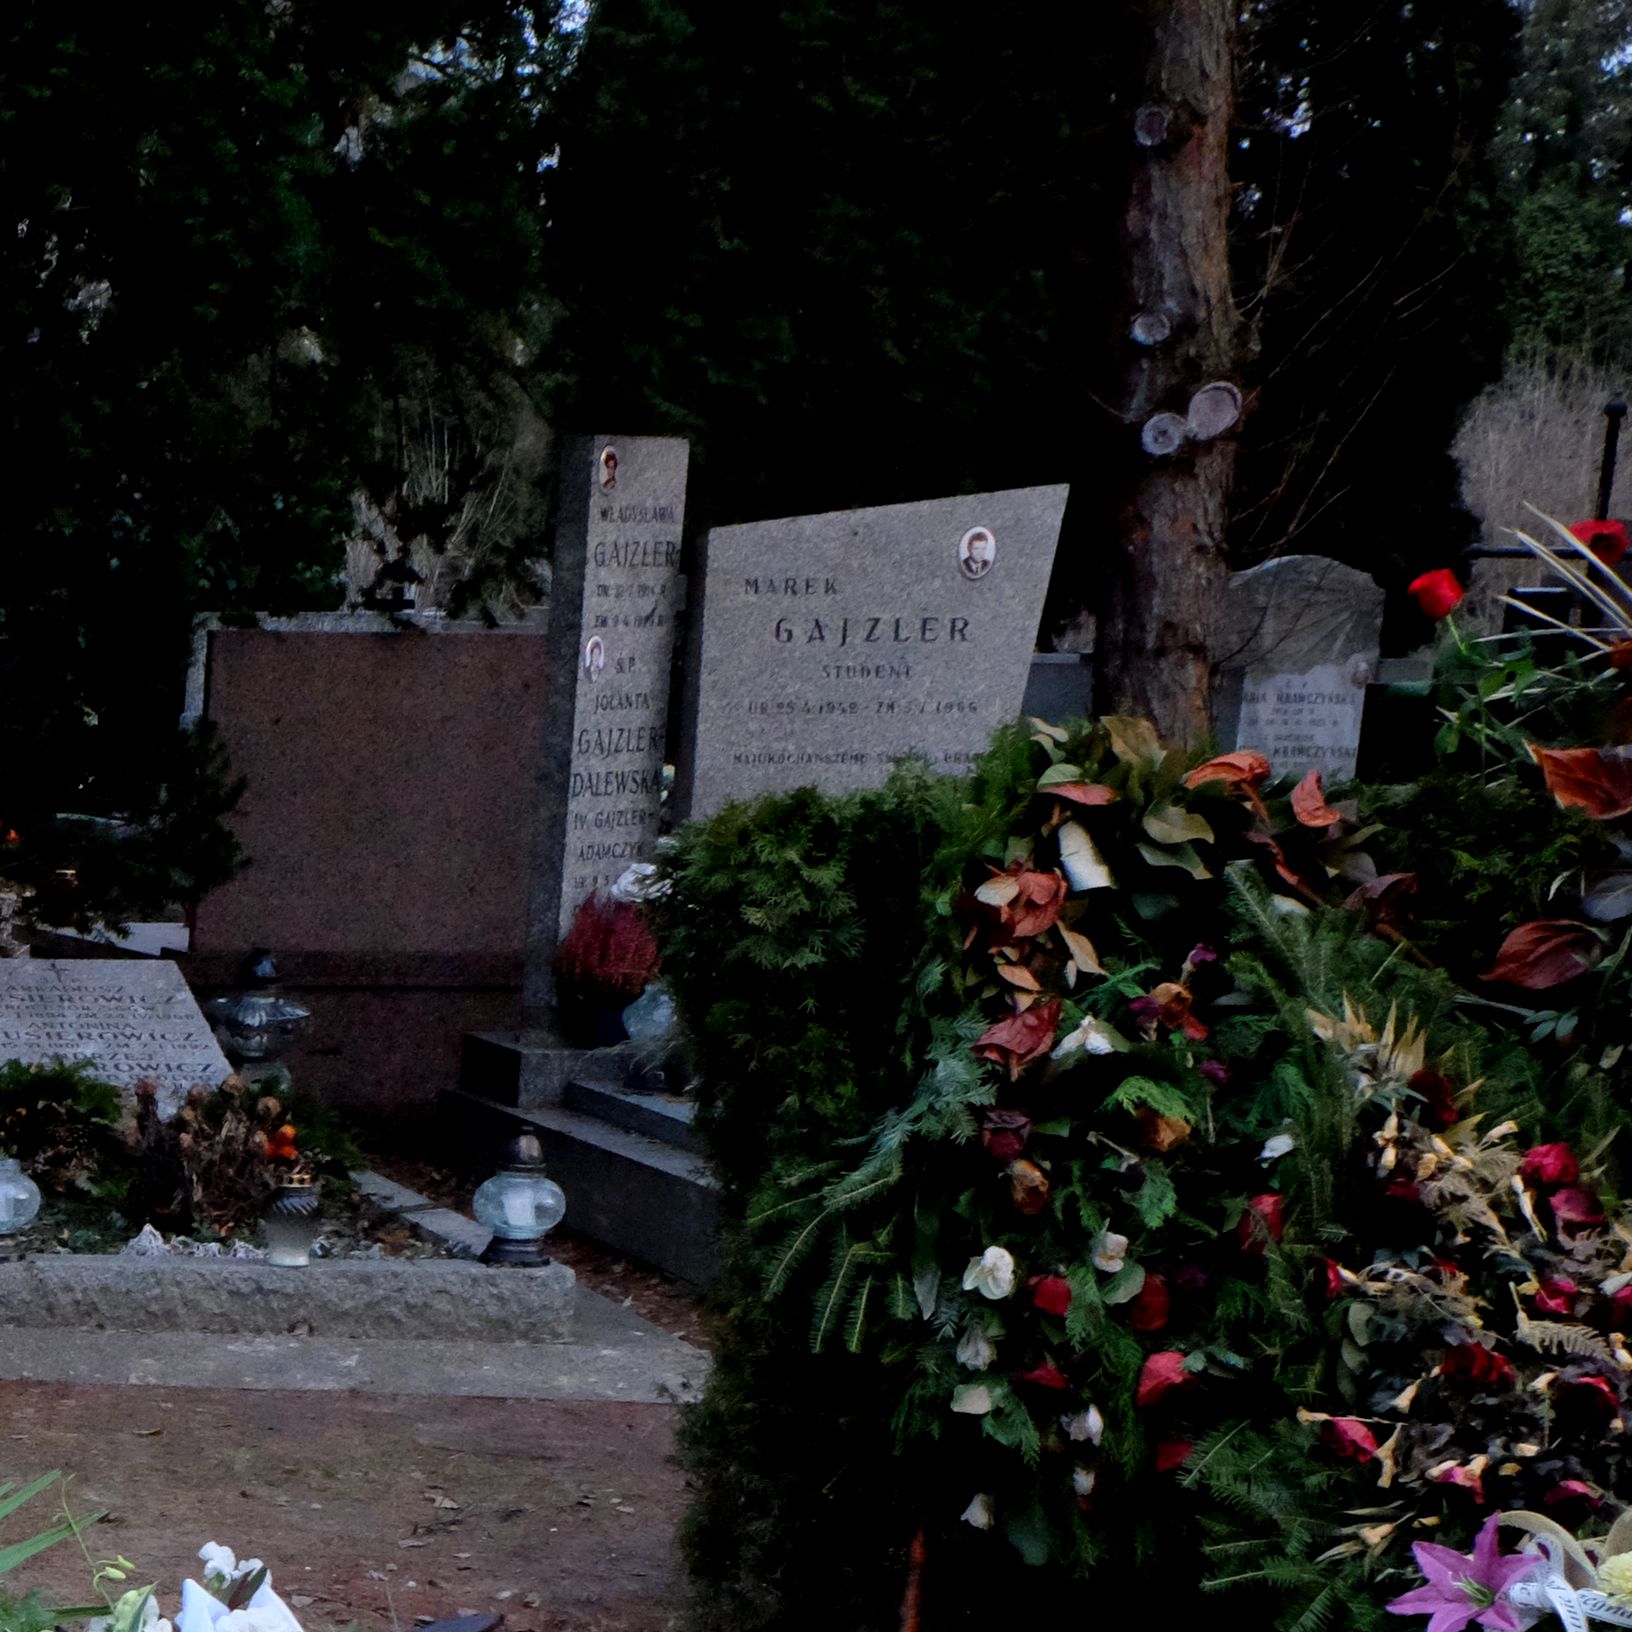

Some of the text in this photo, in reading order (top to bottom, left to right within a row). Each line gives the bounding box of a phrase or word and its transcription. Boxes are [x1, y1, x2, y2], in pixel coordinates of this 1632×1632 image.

[744, 578, 838, 596] MAREK
[775, 617, 971, 647] GAJZLER
[821, 664, 913, 679] STUDENT
